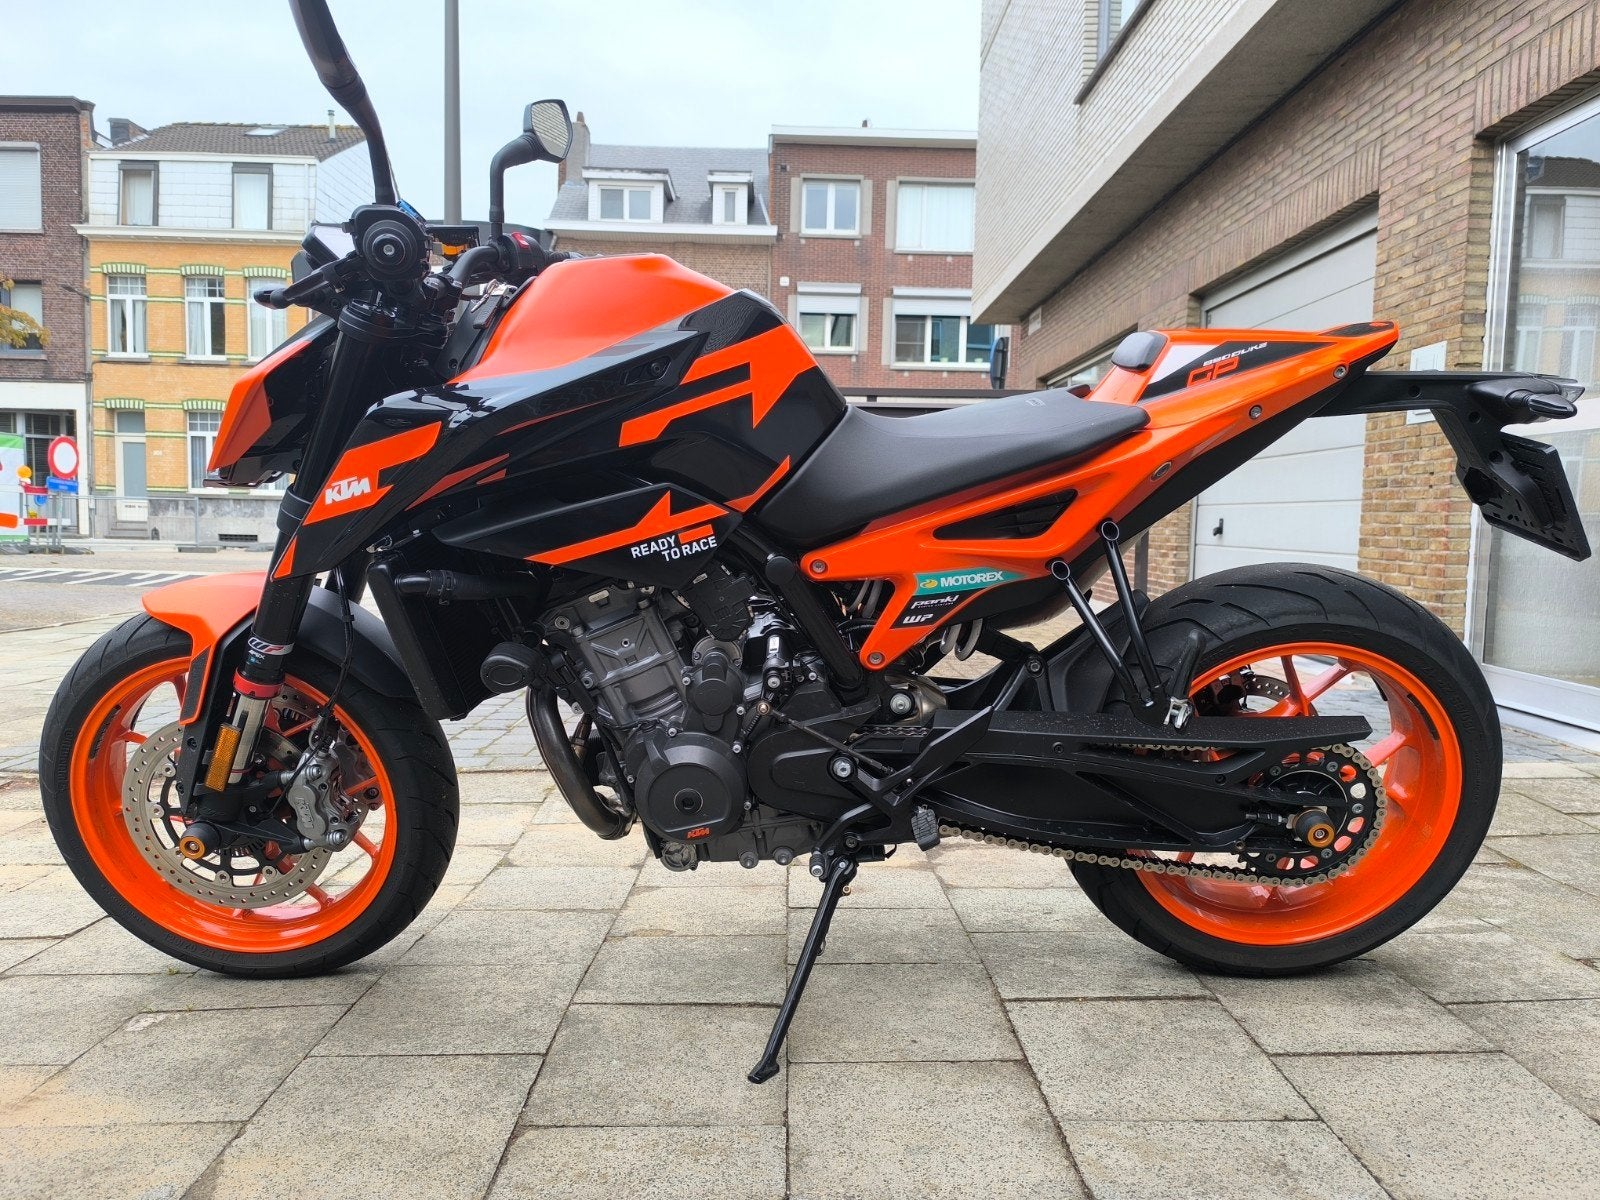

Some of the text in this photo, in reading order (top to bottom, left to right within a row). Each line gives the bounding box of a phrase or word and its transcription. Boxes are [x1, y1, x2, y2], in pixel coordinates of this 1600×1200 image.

[1187, 356, 1240, 388] GP
[325, 476, 371, 505] KTM
[630, 535, 676, 559] READY
[661, 536, 718, 562] TO RACE
[940, 571, 1005, 588] MOTOREX
[902, 613, 934, 624] WP
[687, 827, 710, 839] KTM
